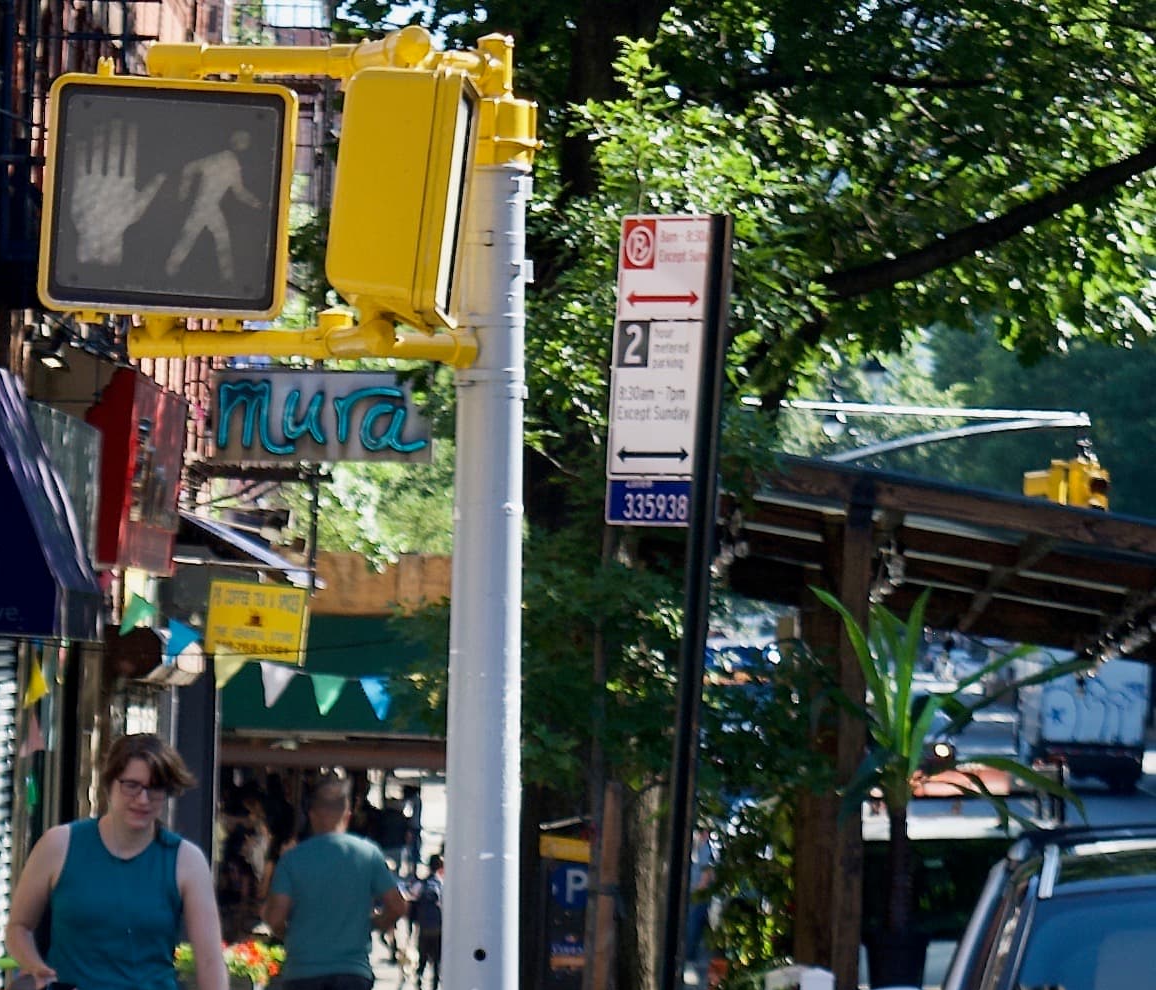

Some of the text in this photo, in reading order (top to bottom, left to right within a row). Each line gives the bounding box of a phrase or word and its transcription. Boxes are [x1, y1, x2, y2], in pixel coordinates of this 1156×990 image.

[624, 324, 643, 364] 2
[617, 405, 691, 423] Except Sunday
[623, 493, 689, 519] 335938
